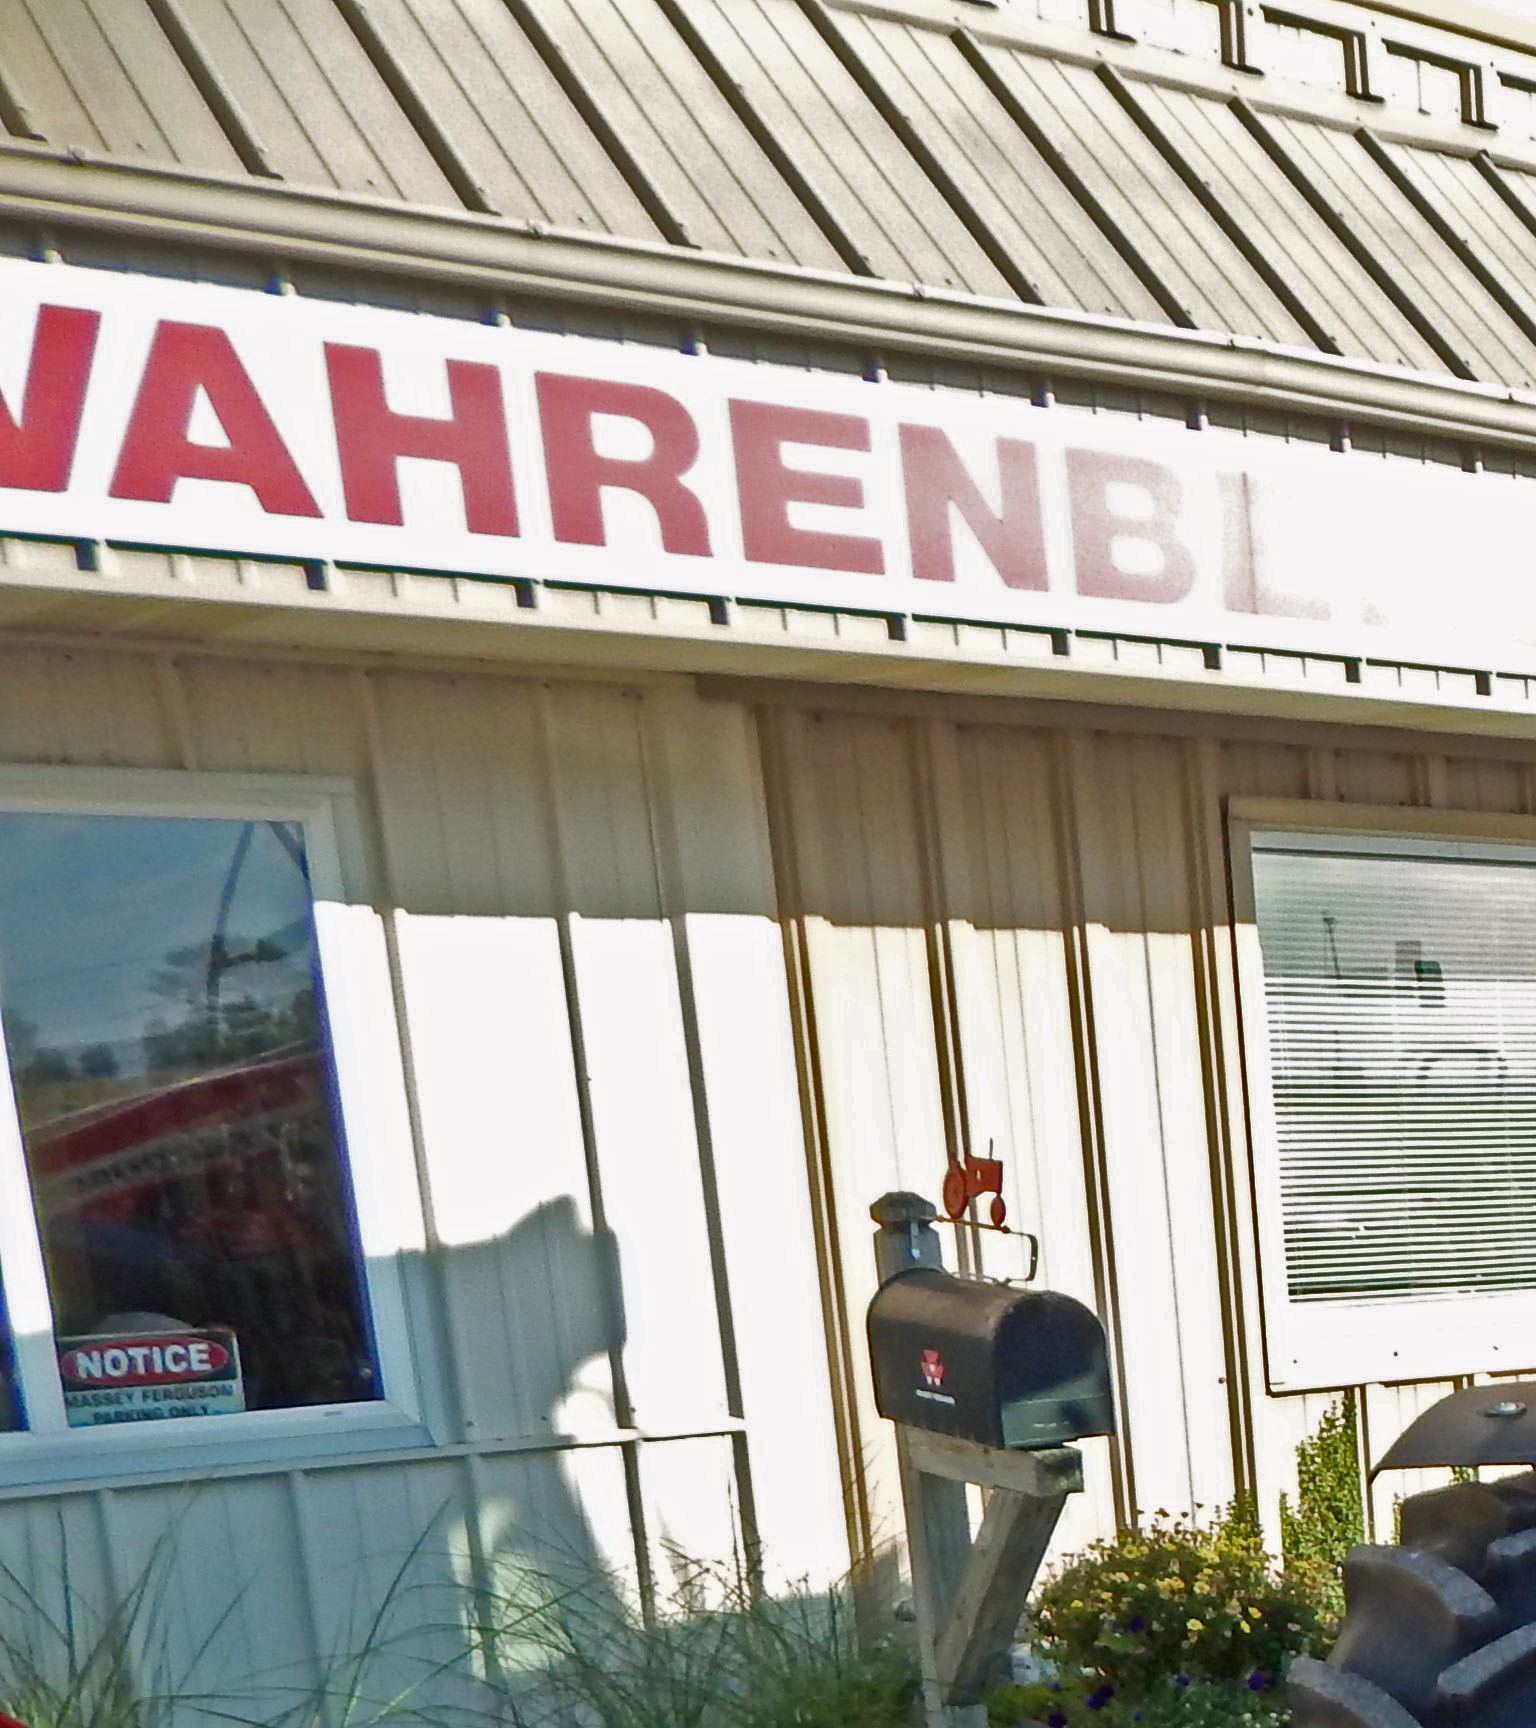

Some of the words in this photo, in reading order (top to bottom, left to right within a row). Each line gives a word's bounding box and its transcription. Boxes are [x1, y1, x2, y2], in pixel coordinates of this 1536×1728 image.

[77, 1343, 211, 1379] NOTICE
[67, 1391, 135, 1408] MASSEY
[142, 1383, 234, 1403] FERGUSON
[168, 1404, 210, 1419] ONLY
